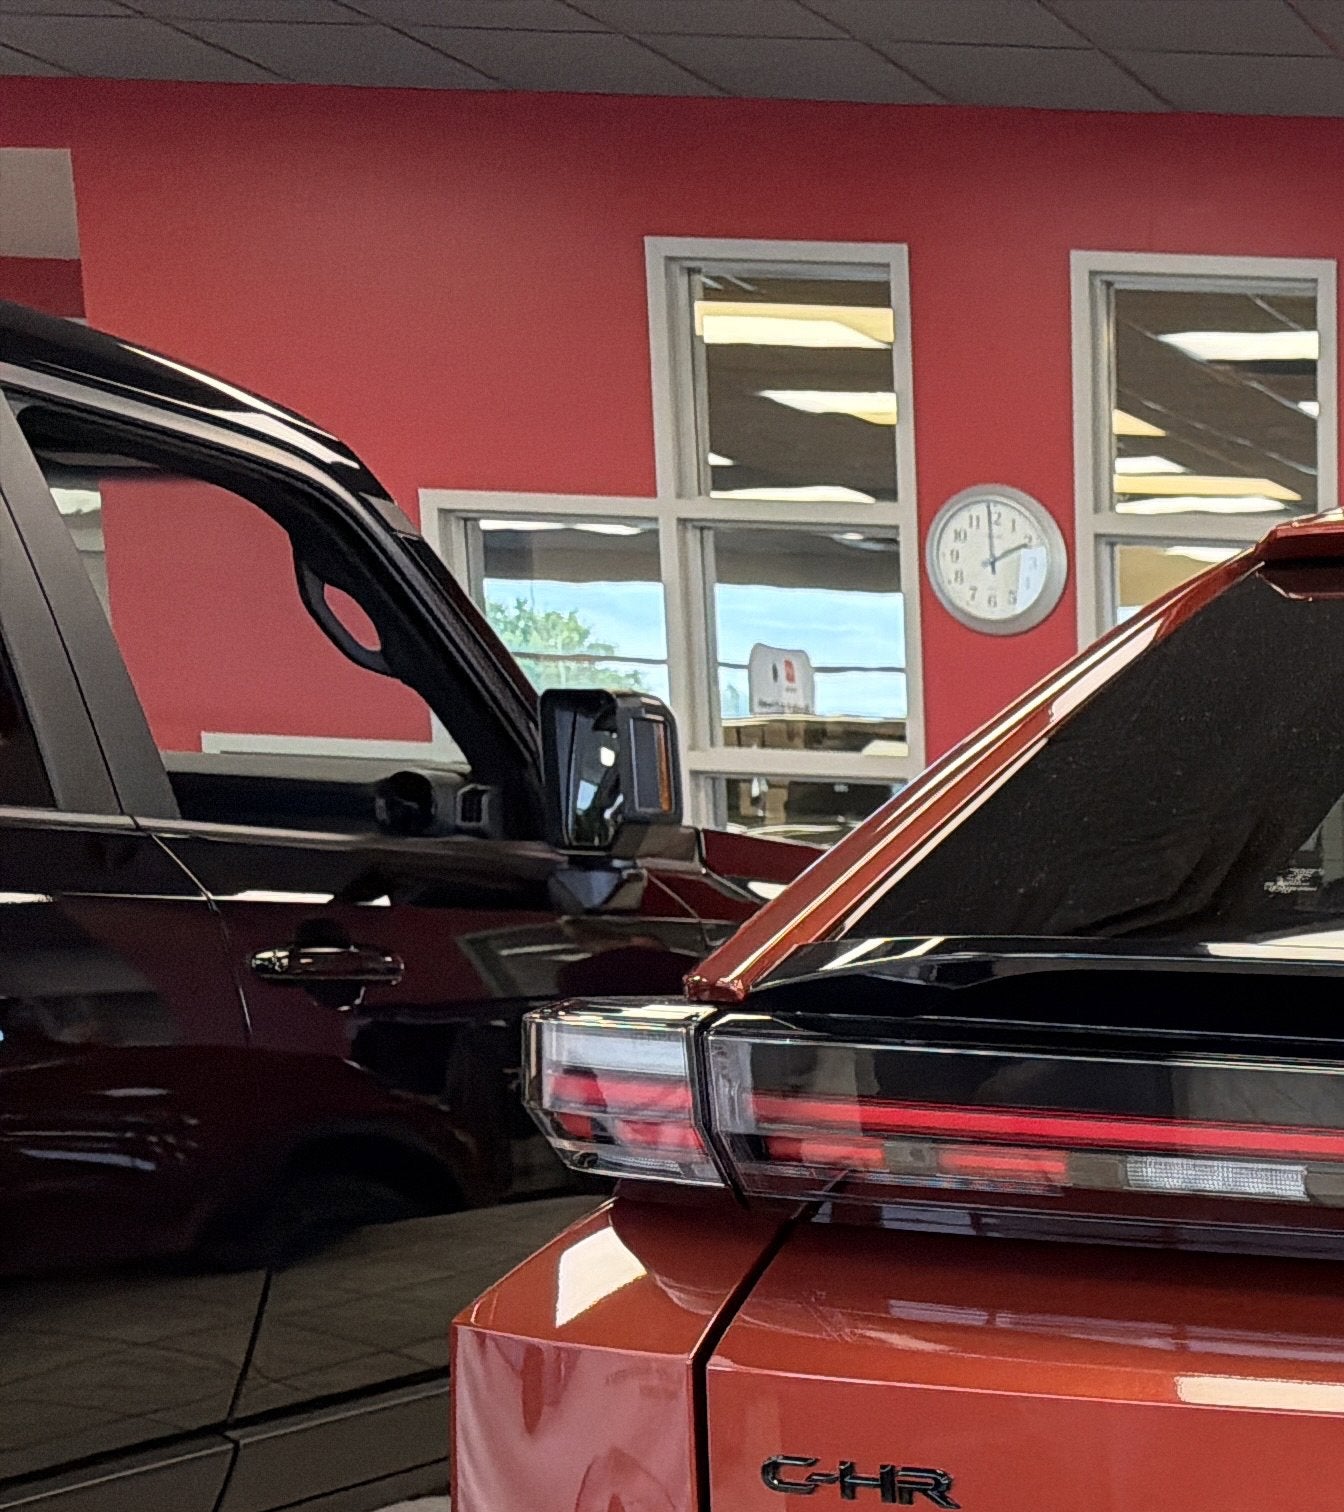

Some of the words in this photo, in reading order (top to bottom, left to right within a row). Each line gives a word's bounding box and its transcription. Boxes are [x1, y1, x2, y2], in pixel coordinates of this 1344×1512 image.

[968, 513, 981, 530] 11
[953, 528, 968, 544] 10
[950, 548, 961, 562] 9
[953, 569, 965, 584] 8
[968, 586, 979, 602] 7
[987, 594, 998, 609] 6
[761, 1455, 962, 1510] C-HR
